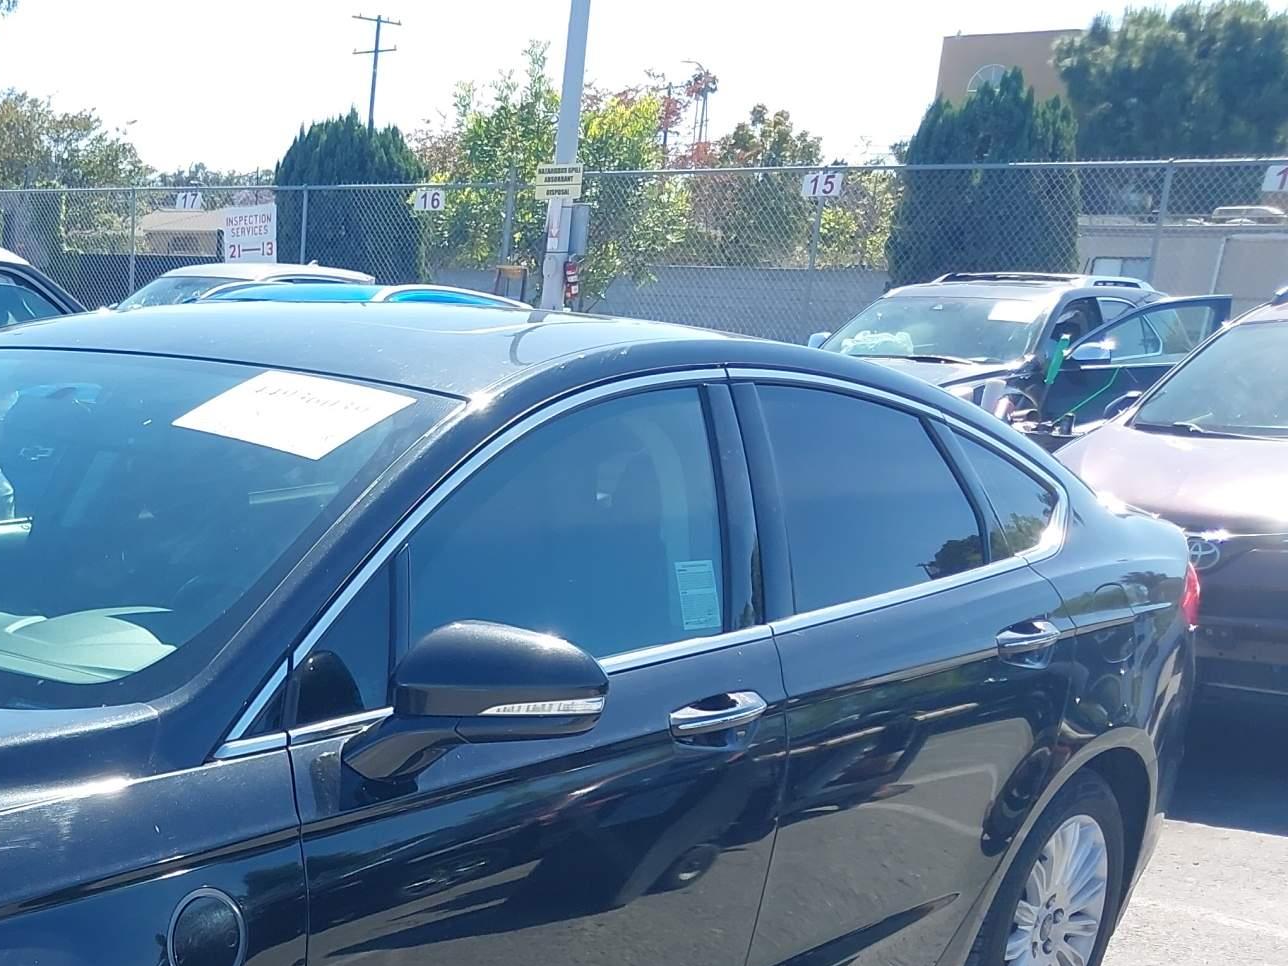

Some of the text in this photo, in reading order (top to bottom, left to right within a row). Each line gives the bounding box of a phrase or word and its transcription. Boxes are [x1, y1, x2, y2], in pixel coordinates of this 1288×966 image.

[810, 174, 836, 195] 15
[182, 192, 198, 209] 17
[420, 191, 441, 210] 16
[226, 213, 272, 226] INSPECTION
[231, 225, 269, 238] SERVICES
